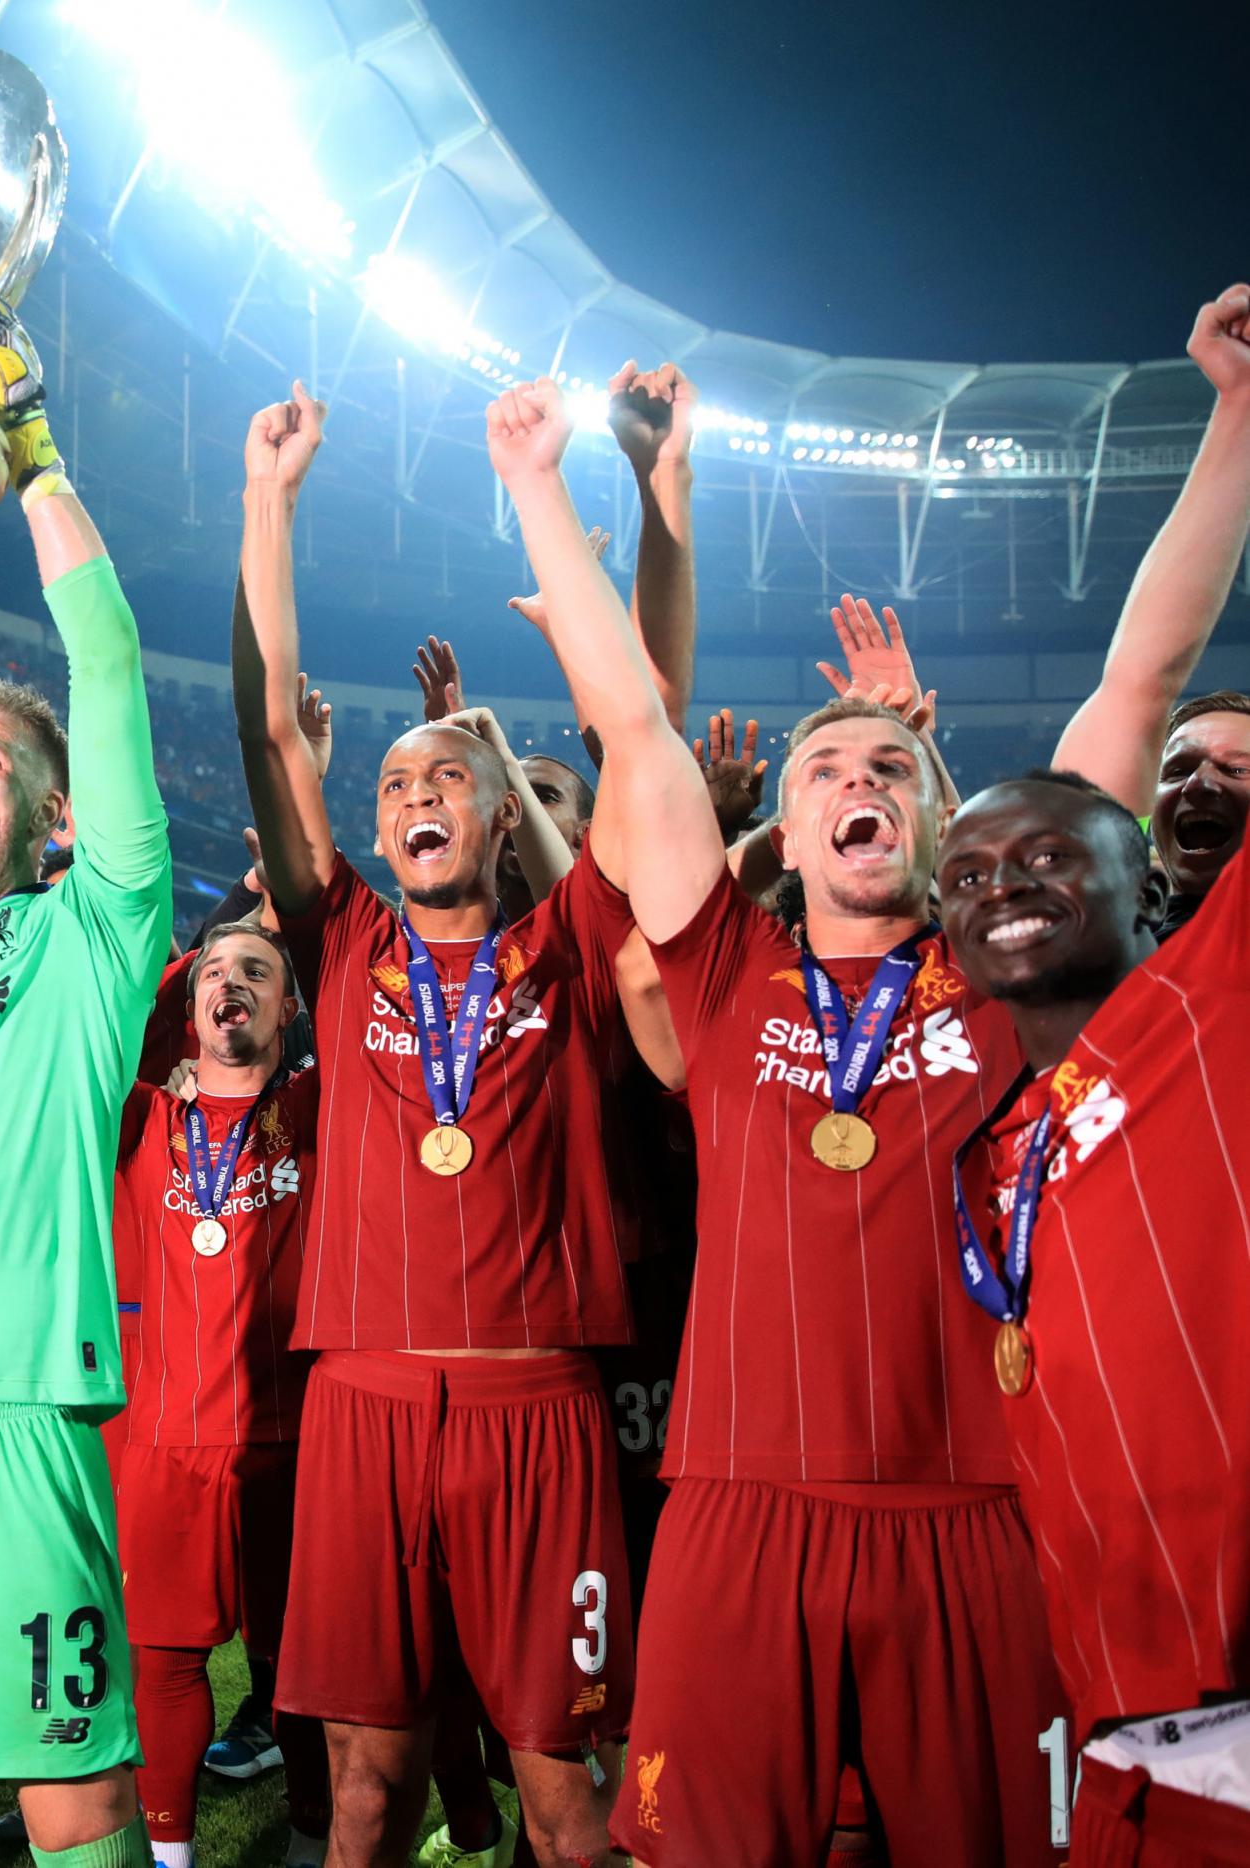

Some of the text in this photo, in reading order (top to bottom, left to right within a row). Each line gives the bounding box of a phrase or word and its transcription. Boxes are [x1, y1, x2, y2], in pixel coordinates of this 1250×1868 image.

[418, 983, 446, 1086] ISTANBUL 2019
[465, 994, 482, 1018] 2019
[842, 1039, 872, 1093] ISTANBUL
[872, 986, 894, 1010] 2019
[823, 1037, 839, 1062] 2019
[190, 1114, 208, 1190] ISTANBUL 2019
[212, 1163, 230, 1203] ISTANBUL
[963, 1247, 984, 1286] 2019
[1015, 1198, 1032, 1277] ISTANBUL
[20, 1605, 110, 1713] 13
[572, 1569, 608, 1675] 3
